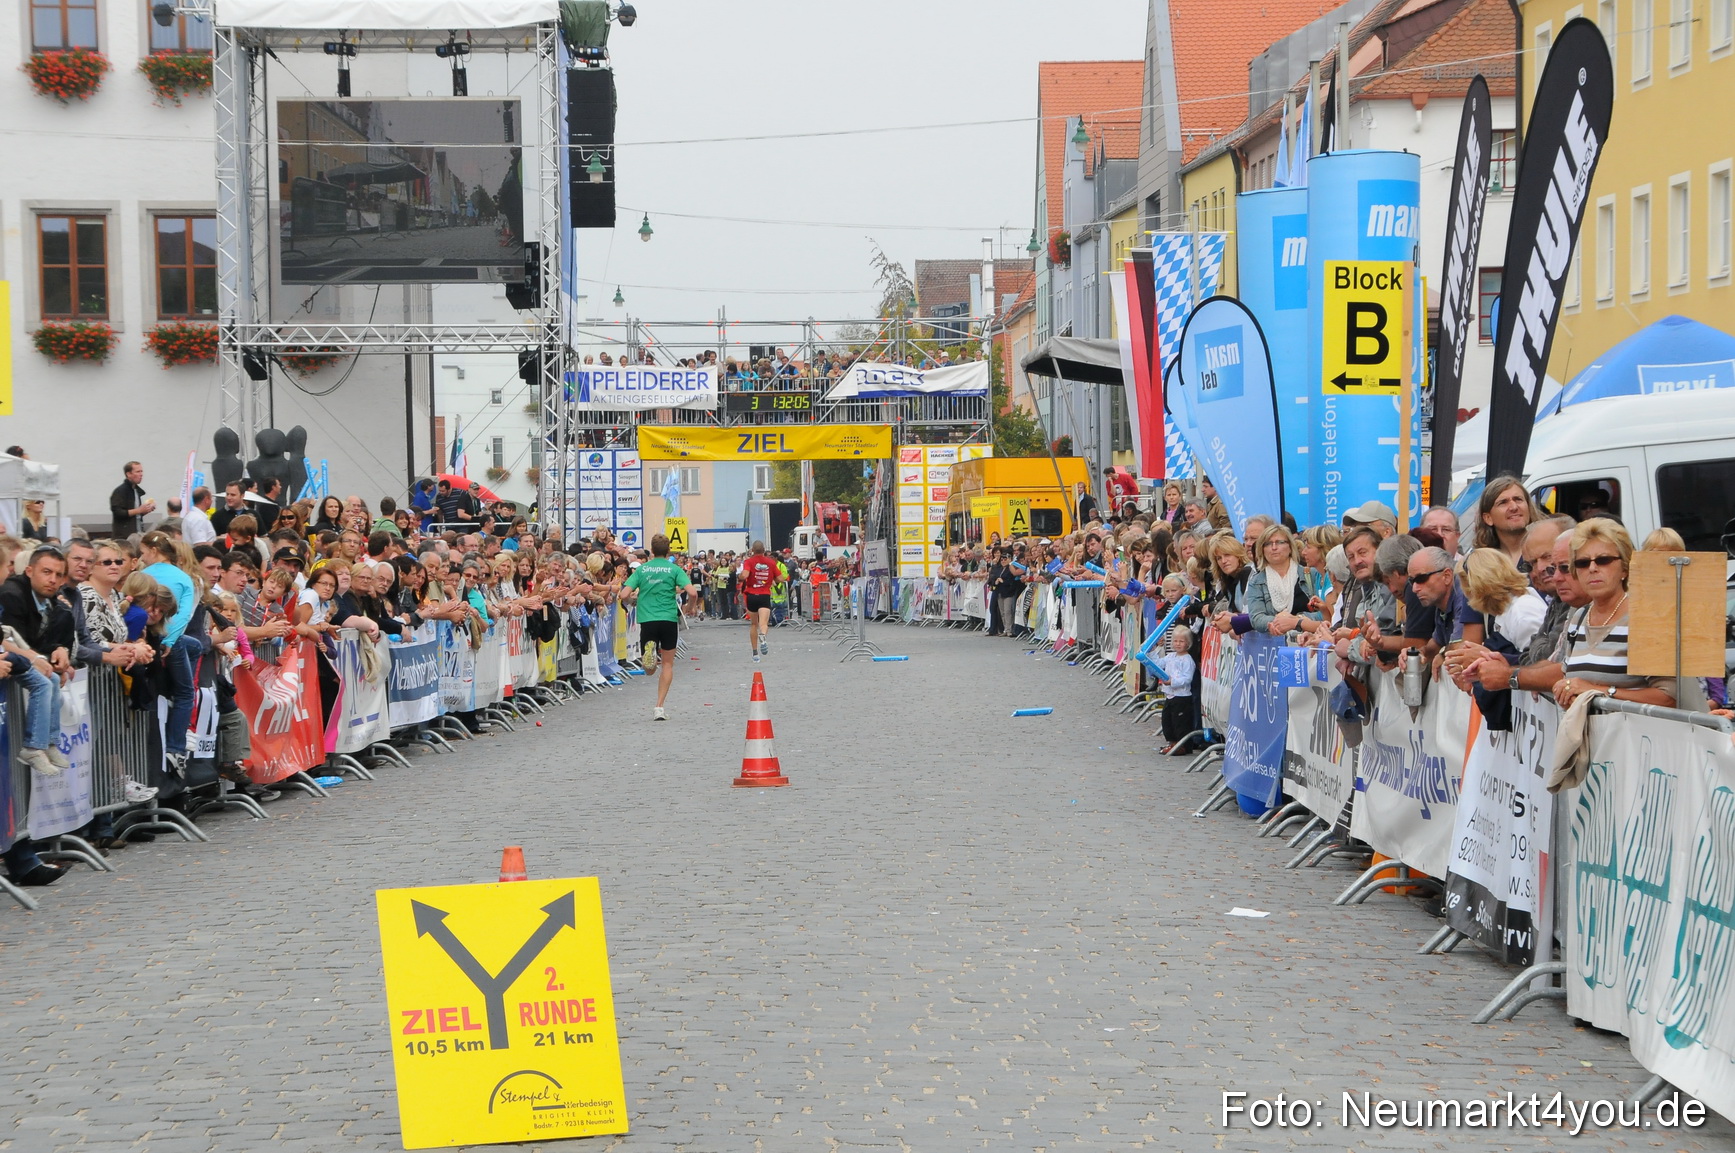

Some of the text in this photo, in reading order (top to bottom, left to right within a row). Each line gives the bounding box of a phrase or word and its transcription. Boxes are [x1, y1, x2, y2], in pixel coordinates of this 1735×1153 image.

[1442, 115, 1481, 345] THULE
[1504, 89, 1598, 405] THULE
[1334, 266, 1403, 291] Block
[1345, 301, 1390, 365] B
[592, 371, 710, 391] PFLEIDERER
[592, 393, 712, 404] AKTIENGESELLSCHAFT
[751, 395, 810, 410] 3 1:32:05
[737, 433, 795, 454] ZIEL
[1009, 499, 1028, 507] Block
[1322, 470, 1341, 527] ünstig
[1012, 508, 1026, 525] A
[669, 527, 683, 544] A
[641, 565, 673, 574] Sinupret
[544, 966, 565, 992] 2.
[402, 1006, 482, 1036] ZIEL
[518, 998, 598, 1028] RUNDE
[405, 1038, 485, 1057] 10,5 km
[533, 1030, 594, 1047] 21 km
[500, 1085, 550, 1106] Stempel
[564, 1098, 613, 1109] Werbedesign
[533, 1112, 576, 1120] BRIGITTE
[565, 1119, 585, 1127] 92318
[586, 1117, 616, 1126] Neumarkt
